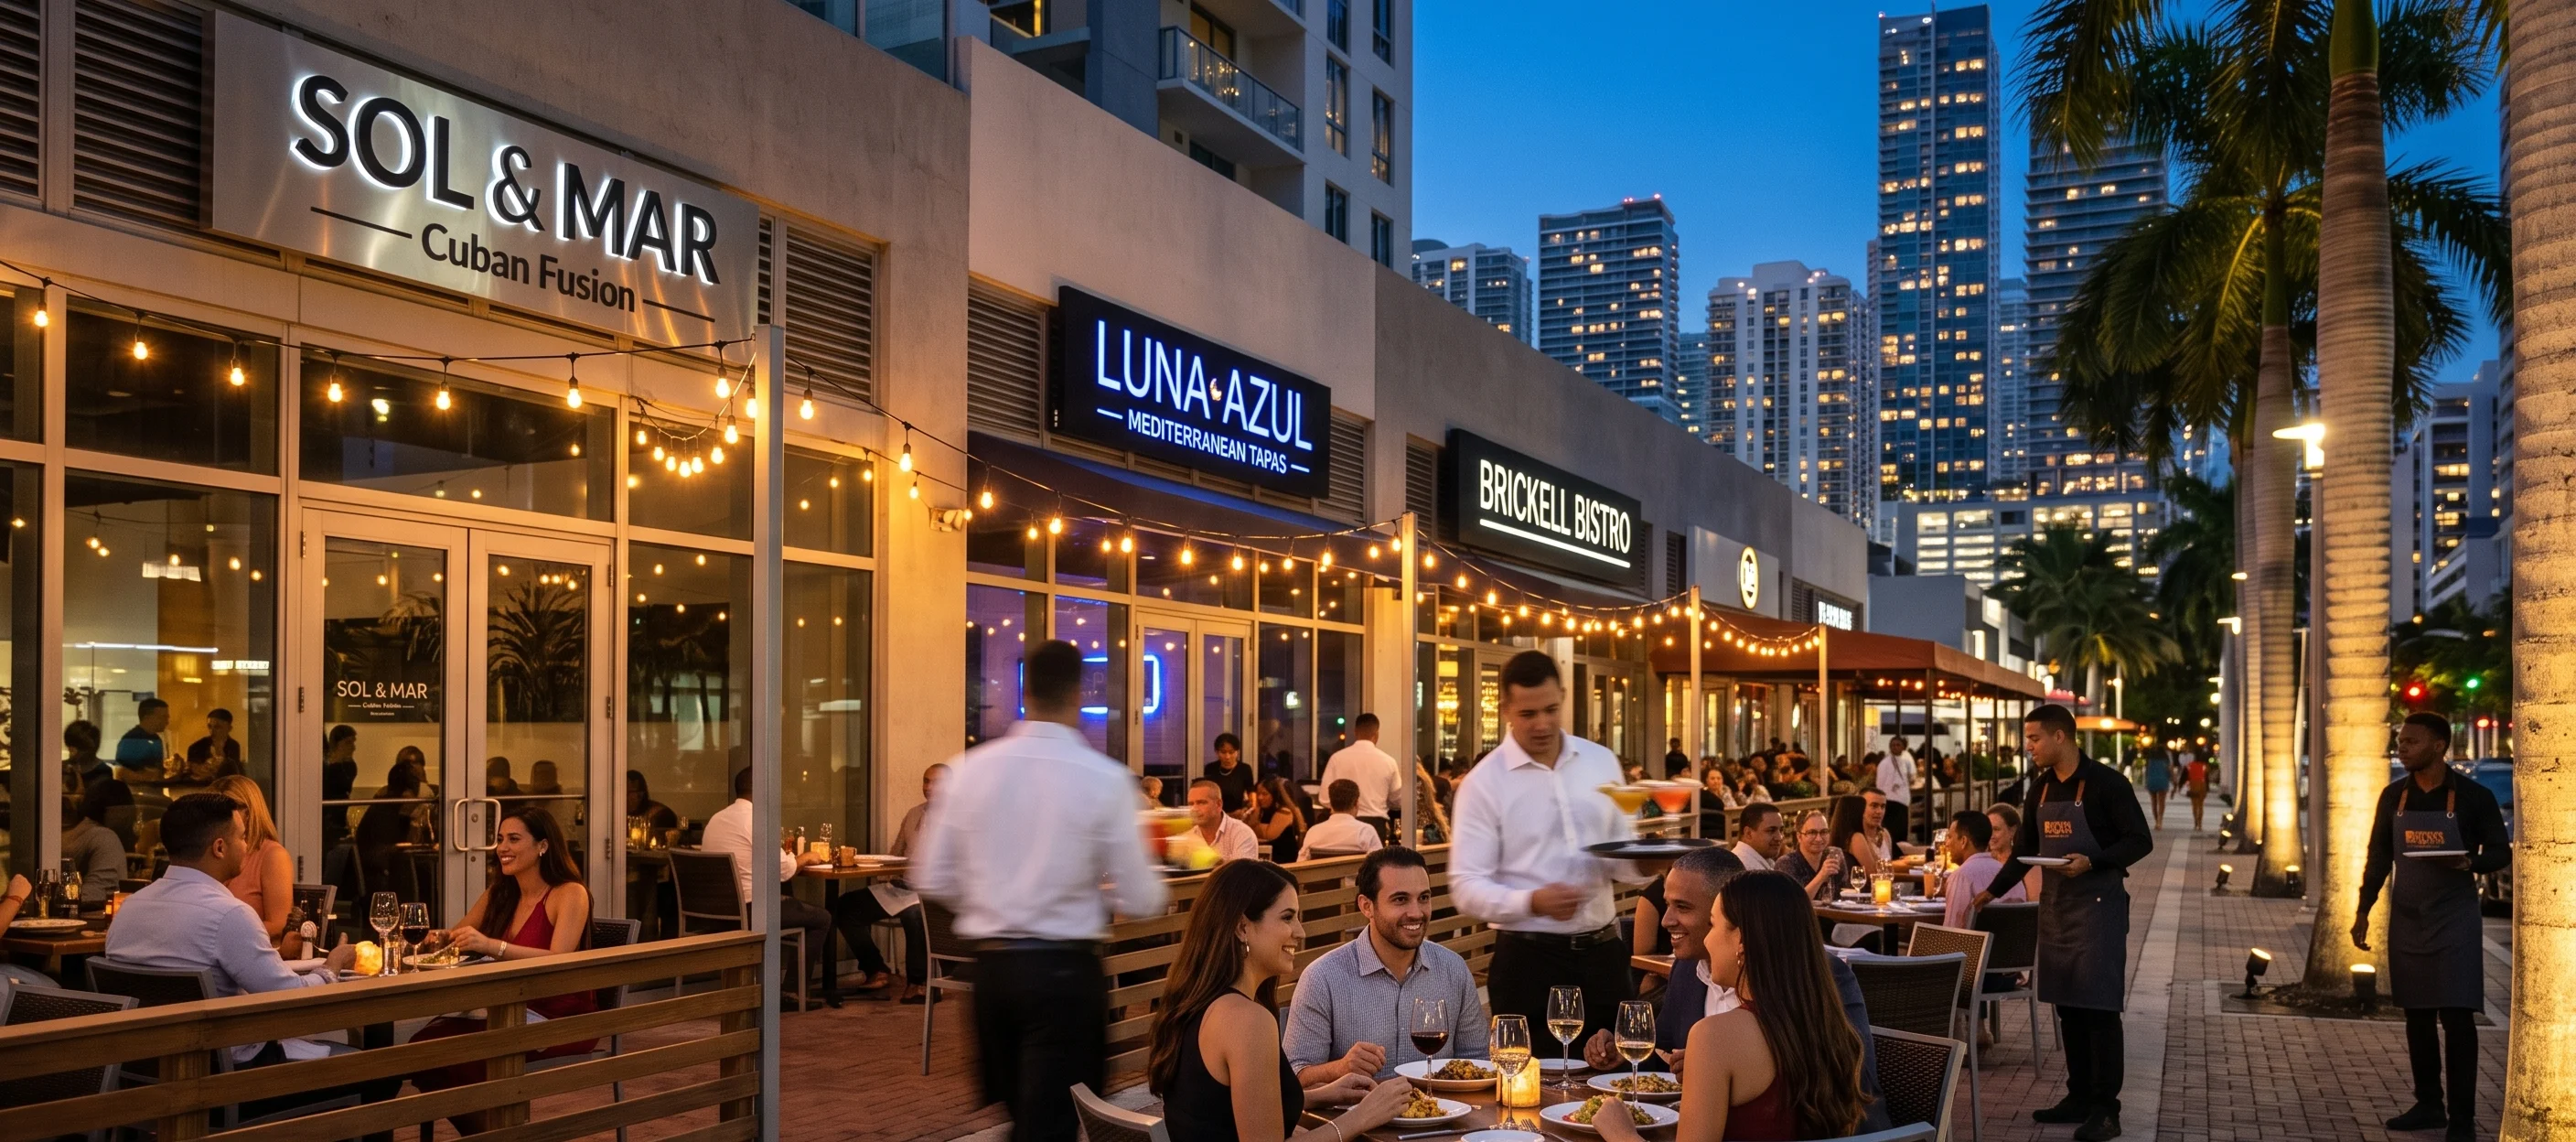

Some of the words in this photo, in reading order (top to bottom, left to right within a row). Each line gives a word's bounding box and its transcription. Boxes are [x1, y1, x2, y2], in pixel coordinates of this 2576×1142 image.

[293, 73, 475, 210] SOL
[487, 145, 546, 232] &
[558, 162, 721, 286] MAR
[421, 222, 531, 285] Cuban
[539, 254, 636, 313] Fusion
[1097, 319, 1211, 420] LUNA
[1222, 368, 1313, 451] AZUL
[1128, 408, 1246, 463] MEDITERRANEAN
[1249, 444, 1287, 475] TAPAS
[1479, 458, 1572, 536] BRICKELL
[1574, 493, 1632, 555] BISTRO
[337, 680, 371, 698] SOL
[375, 682, 386, 698] &
[390, 683, 428, 699] MAR
